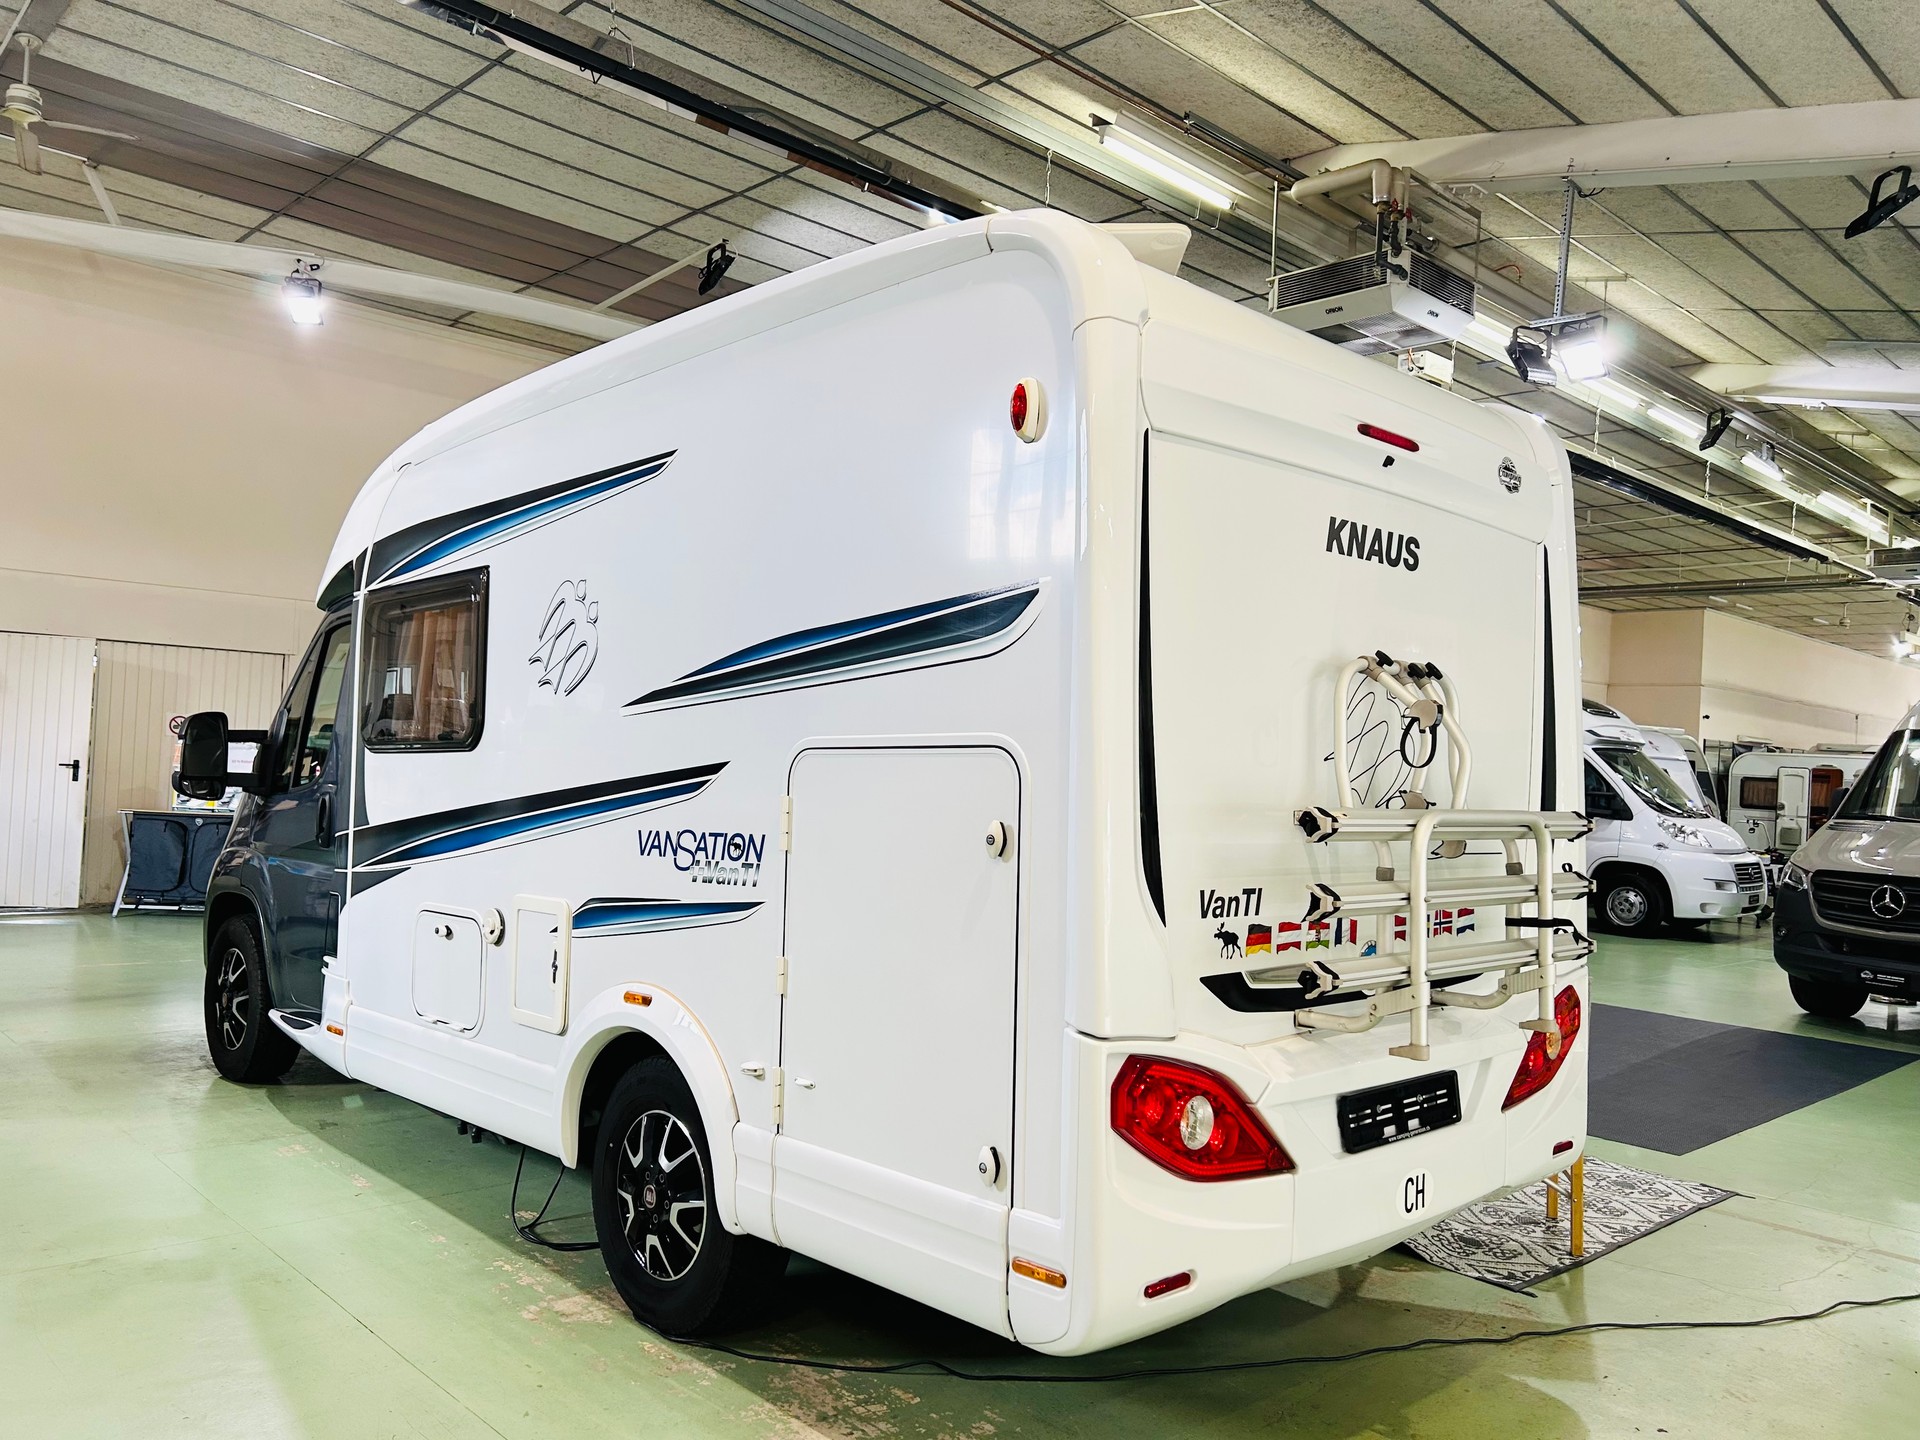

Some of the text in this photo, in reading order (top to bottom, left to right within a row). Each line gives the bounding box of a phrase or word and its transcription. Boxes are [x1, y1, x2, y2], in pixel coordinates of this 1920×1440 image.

[1326, 516, 1420, 572] KNAUS
[638, 829, 766, 871] VANSATION
[1199, 887, 1263, 919] VanTI
[1404, 1173, 1425, 1213] CH
